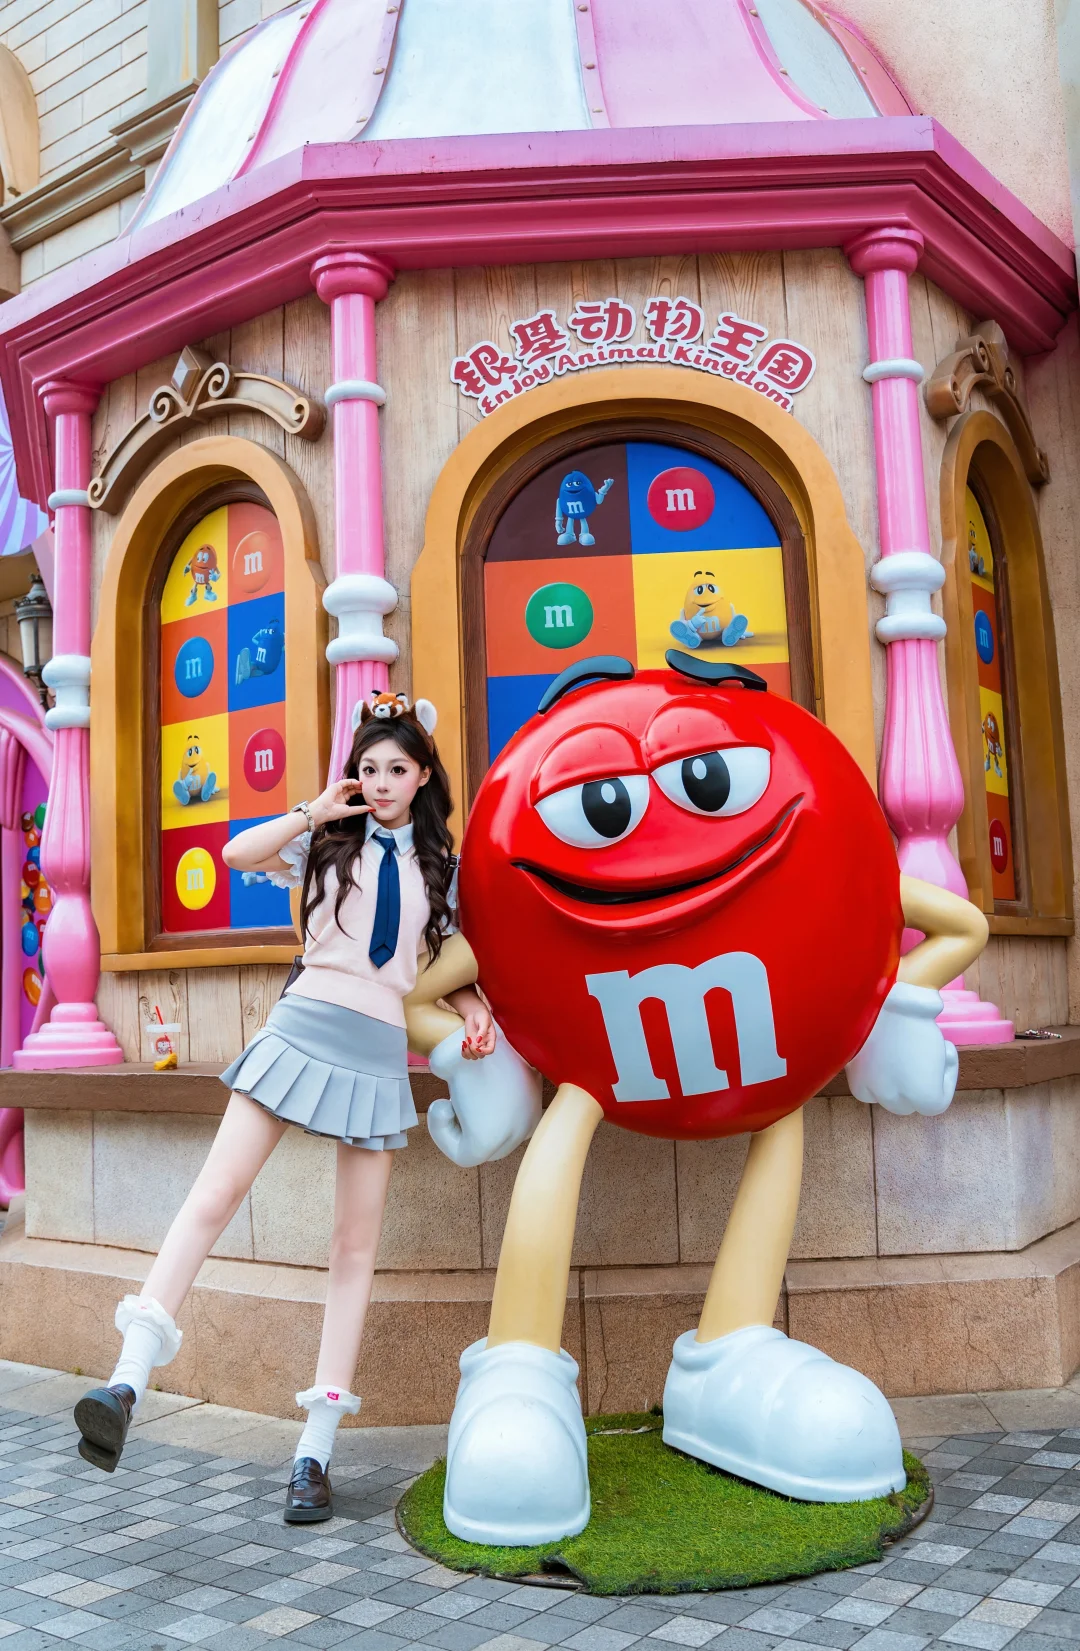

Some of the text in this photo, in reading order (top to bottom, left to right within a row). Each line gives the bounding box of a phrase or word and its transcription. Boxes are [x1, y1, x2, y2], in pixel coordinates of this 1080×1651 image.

[454, 300, 814, 395] 银基动物王国
[481, 343, 791, 414] Enjoy Animal Kingdom
[566, 500, 585, 514] m
[666, 487, 696, 512] m
[243, 549, 263, 576] m
[194, 572, 206, 584] m
[544, 603, 574, 628] m
[185, 655, 203, 680] m
[256, 646, 266, 664] m
[254, 749, 274, 773] m
[993, 836, 1003, 857] m
[186, 867, 204, 891] m
[585, 951, 787, 1102] m
